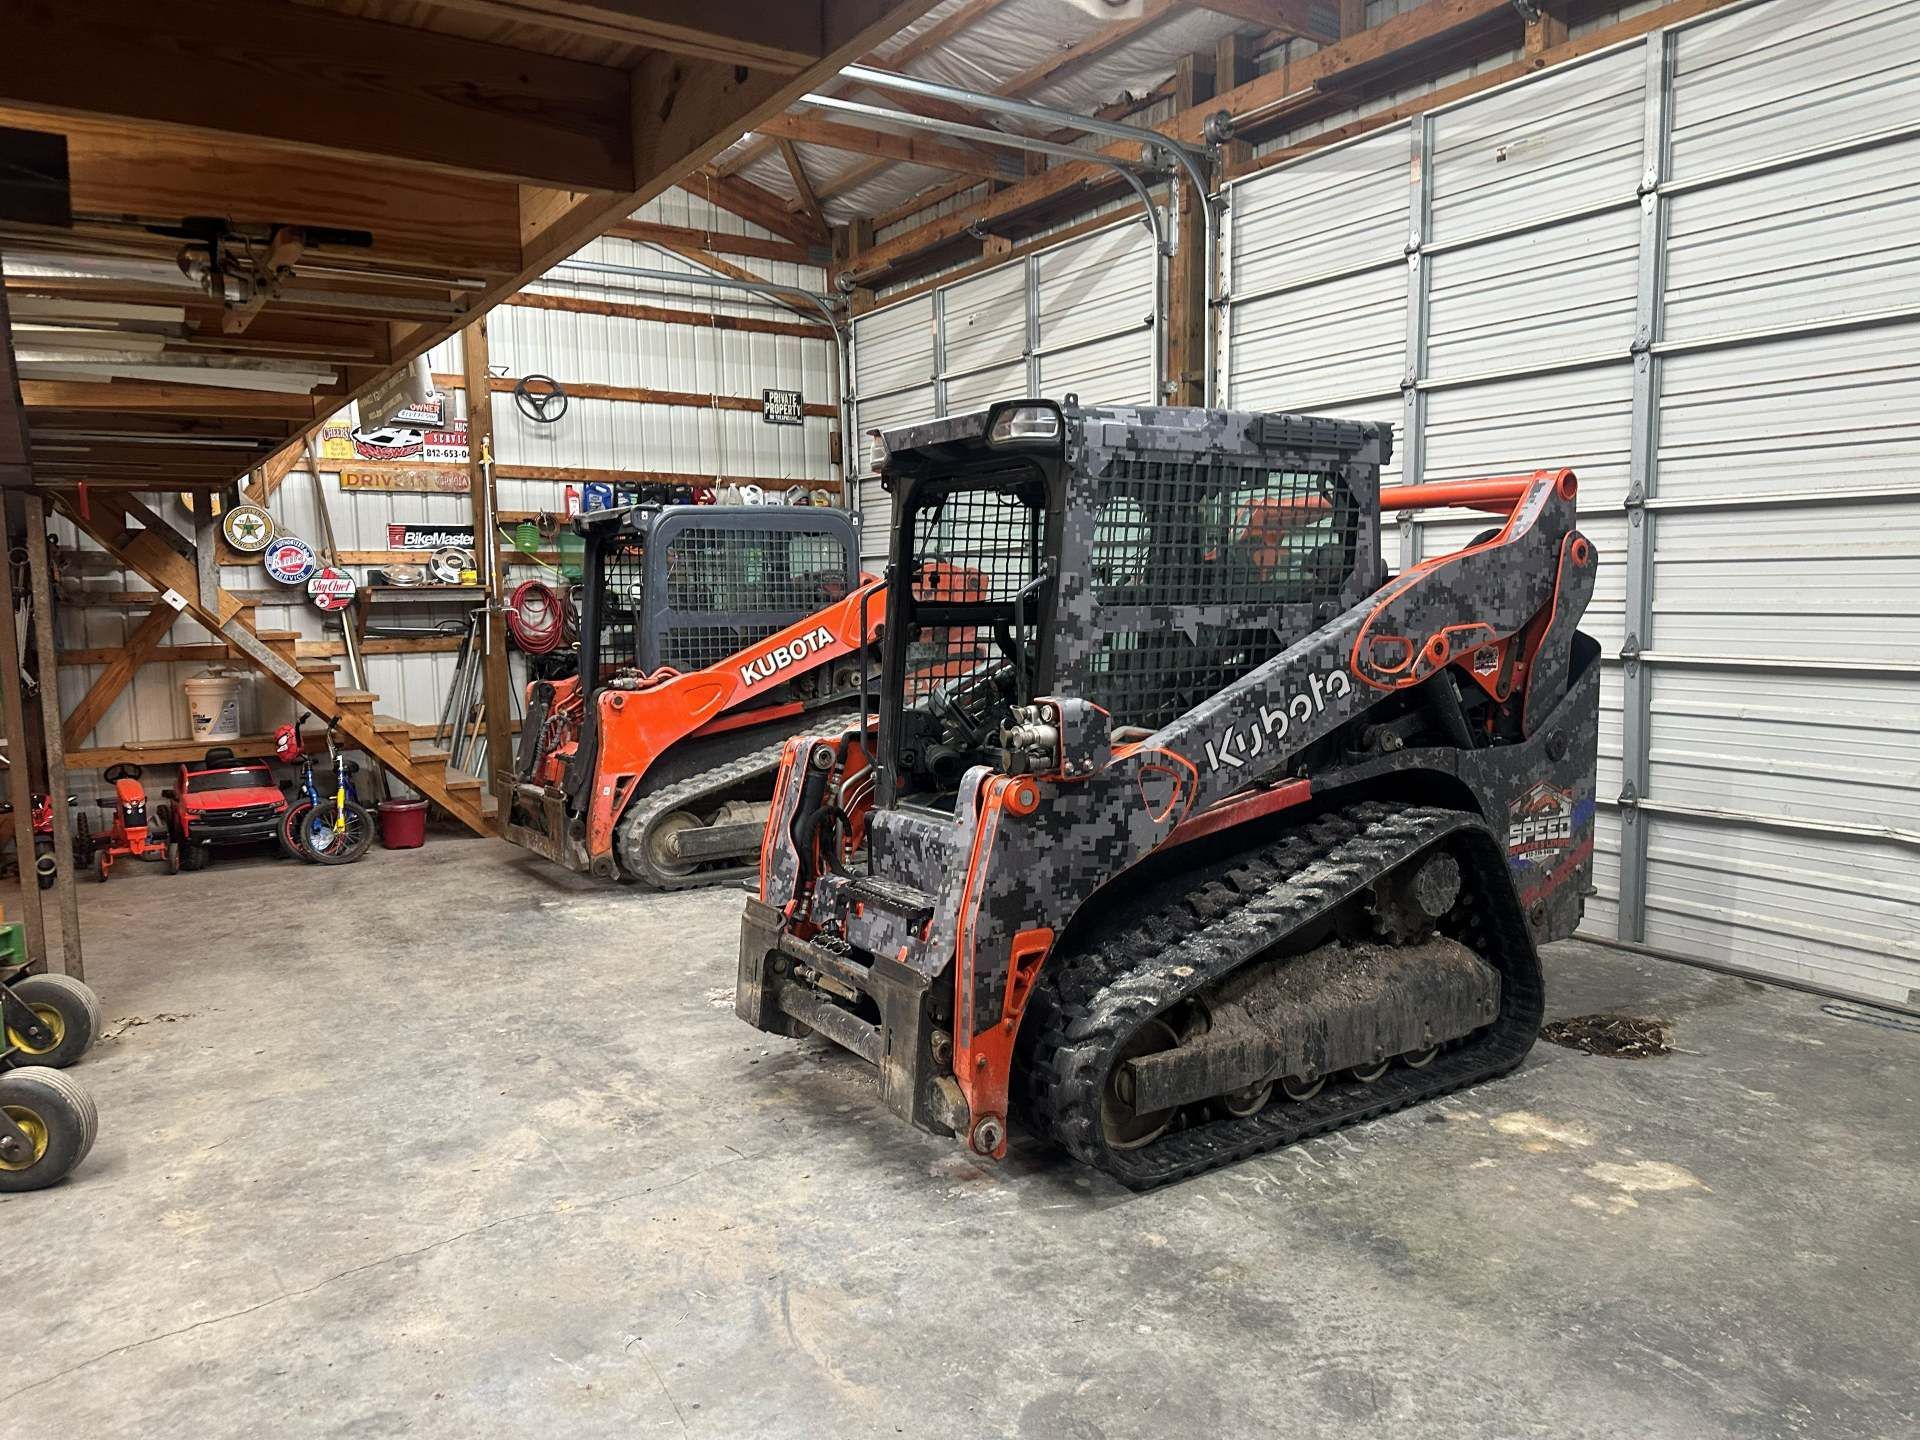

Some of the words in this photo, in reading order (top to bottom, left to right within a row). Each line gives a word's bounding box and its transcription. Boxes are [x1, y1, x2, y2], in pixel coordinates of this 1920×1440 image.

[769, 391, 797, 404] PRIVATE
[410, 403, 440, 414] OWNER
[765, 402, 801, 416] PROPERTY
[454, 422, 468, 432] AUC
[433, 434, 468, 444] SERVIC
[404, 532, 474, 545] BikeMaster
[275, 571, 306, 581] SERVICE
[312, 580, 327, 593] Sky
[328, 580, 351, 592] Chief
[740, 626, 835, 686] KUBOTA
[1204, 669, 1351, 772] Kubota
[1510, 817, 1571, 847] SPEED
